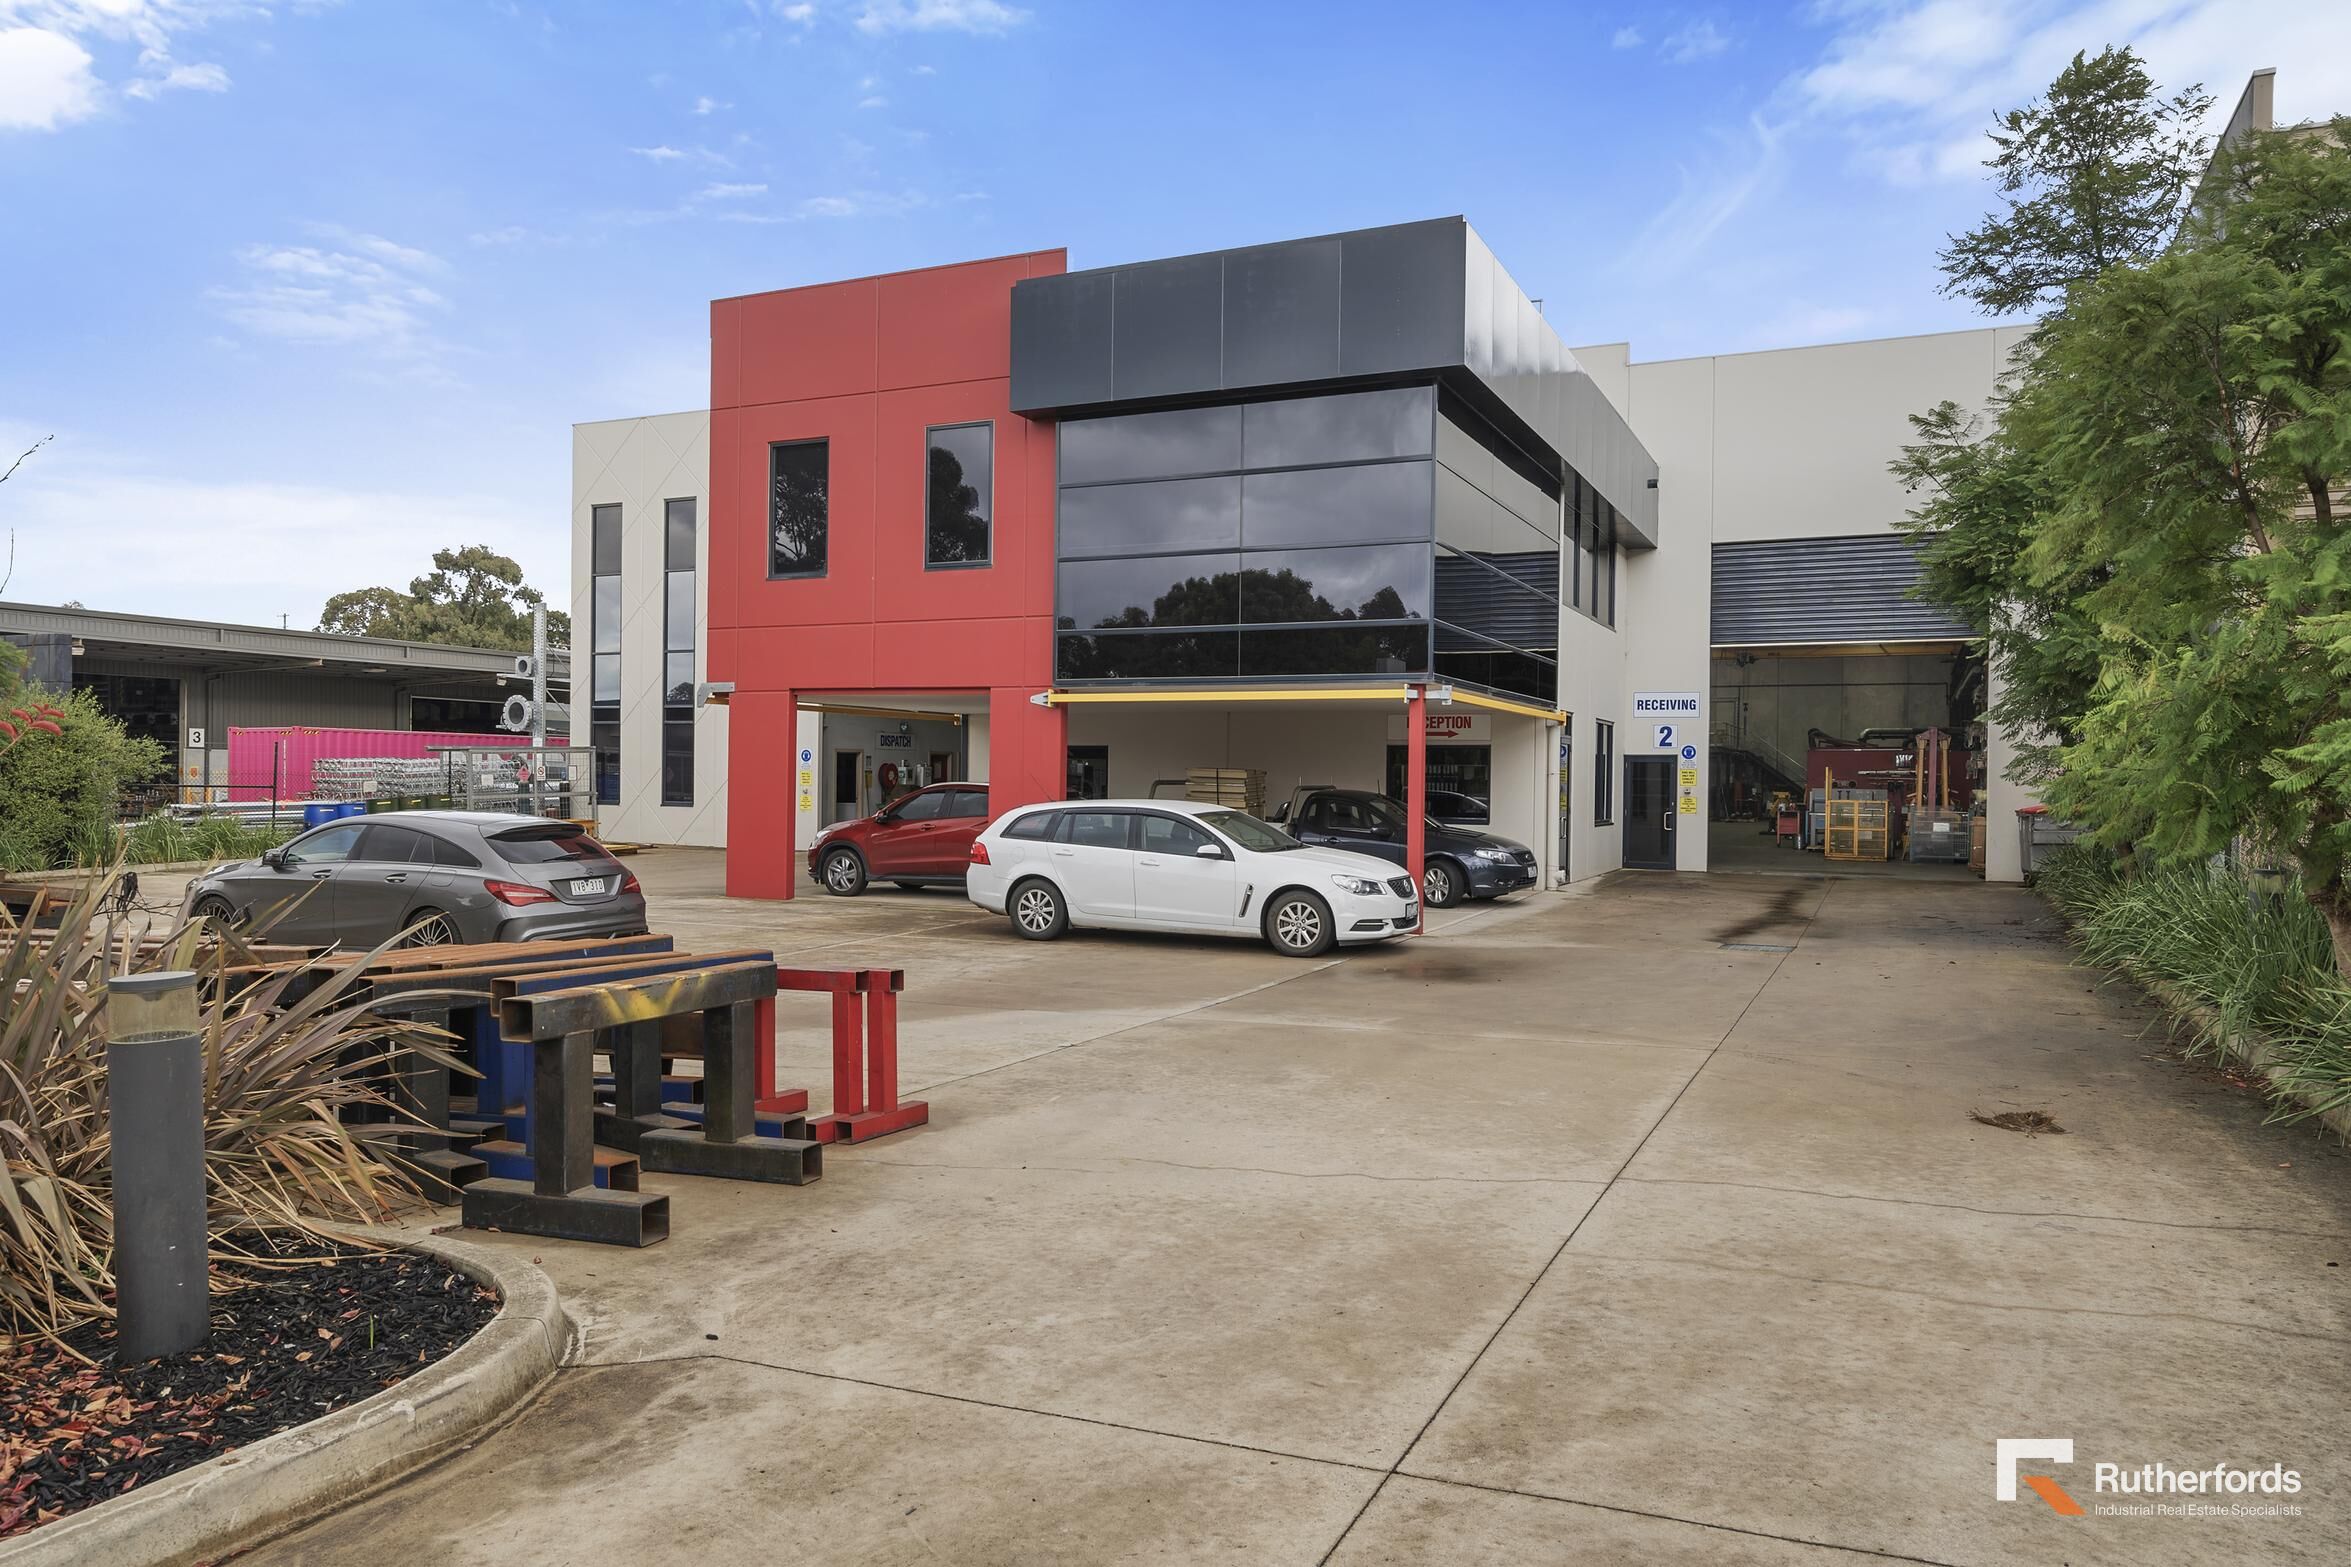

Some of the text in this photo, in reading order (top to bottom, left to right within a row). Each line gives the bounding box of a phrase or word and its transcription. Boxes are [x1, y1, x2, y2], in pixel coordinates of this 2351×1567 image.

[1637, 699, 1697, 711] RECEIVING
[192, 731, 201, 744] 3
[880, 734, 912, 748] DISPATCH
[1659, 725, 1673, 747] 2
